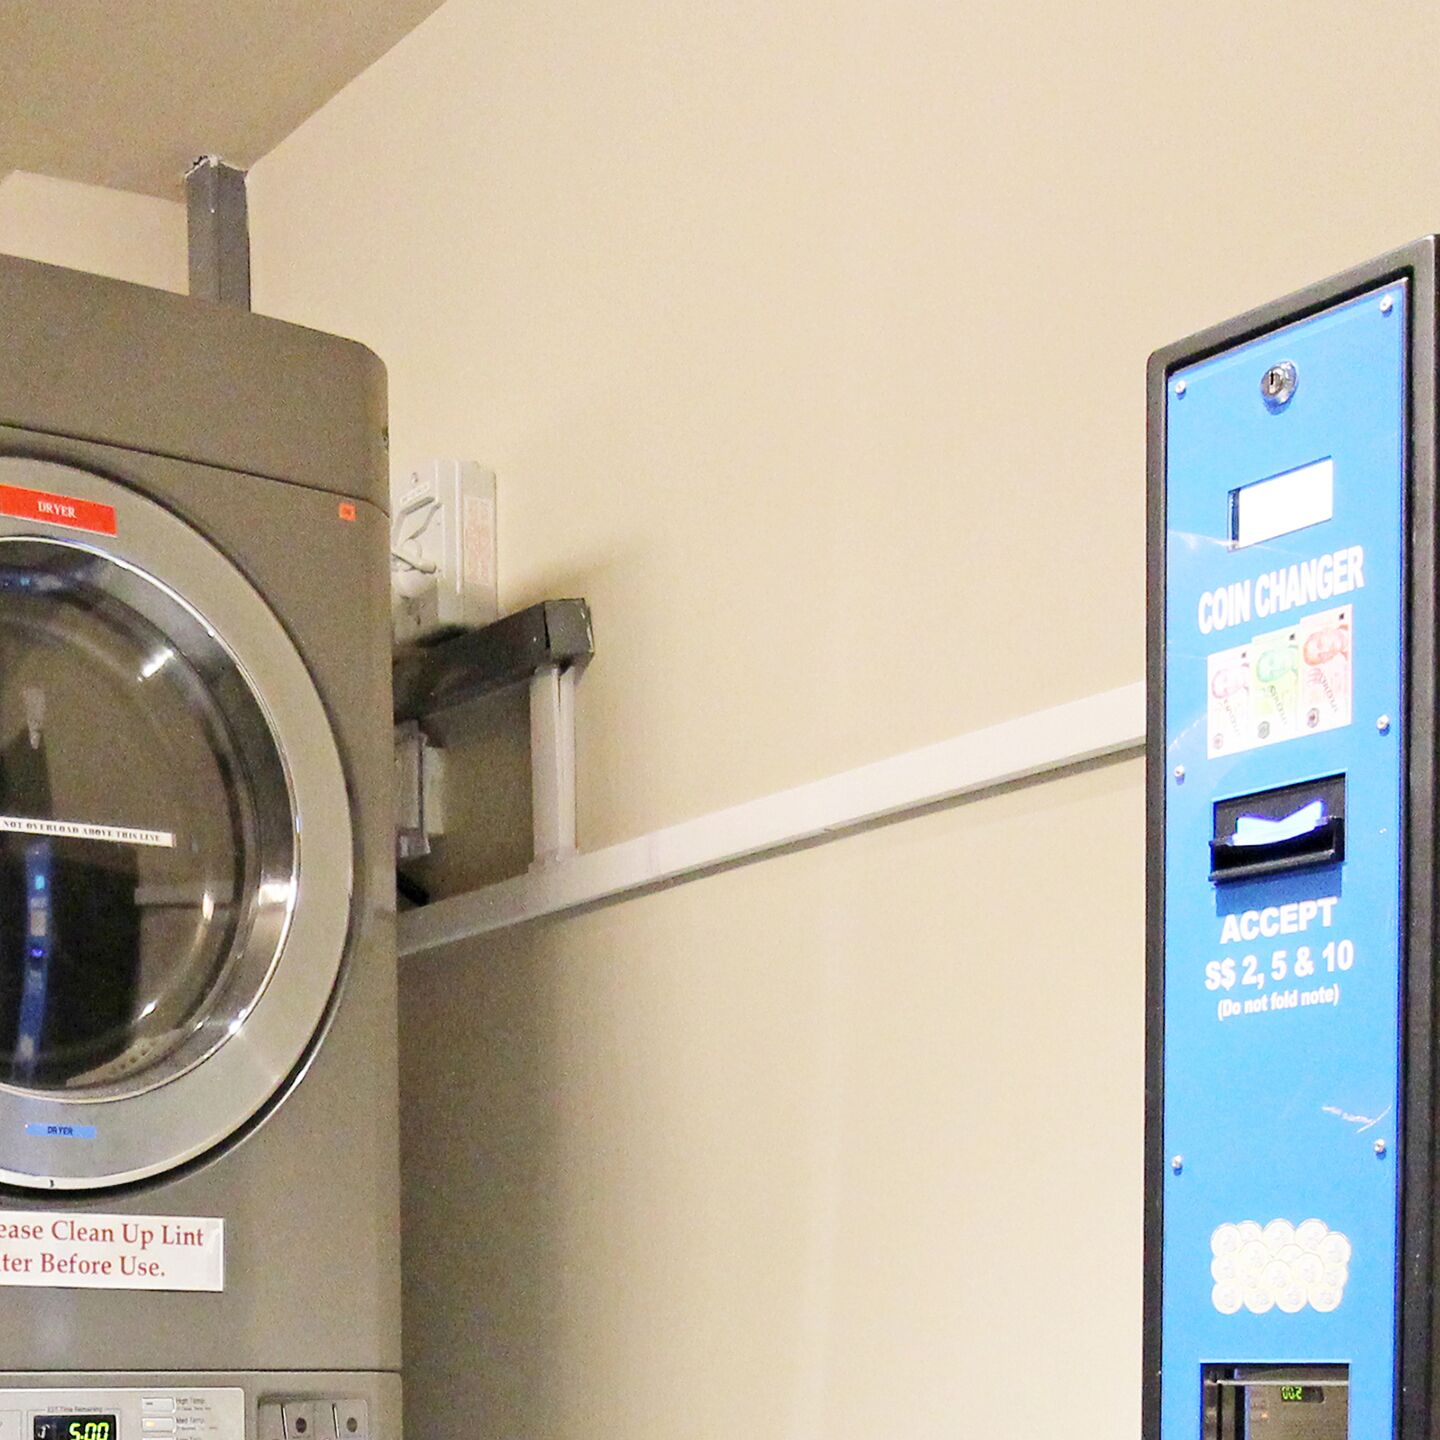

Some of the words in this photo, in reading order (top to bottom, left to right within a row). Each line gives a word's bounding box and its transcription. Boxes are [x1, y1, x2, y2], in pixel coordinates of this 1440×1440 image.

[38, 501, 77, 518] DRYER
[1198, 579, 1251, 635] COIN
[1254, 545, 1365, 618] CHANGER
[4, 820, 22, 829] NOT
[26, 823, 79, 834] OVERLOAD
[83, 828, 112, 838] ABOVE
[116, 831, 138, 840] THIS
[140, 833, 160, 842] LINE
[1219, 896, 1338, 944] ACCEPT
[1204, 957, 1236, 991] S$
[1241, 954, 1265, 990] 2,
[1271, 950, 1287, 981] 5
[1294, 946, 1315, 977] &
[1322, 939, 1354, 972] 10
[1217, 998, 1241, 1021] (Do
[1244, 994, 1268, 1014] not
[1270, 989, 1298, 1010] fold
[1301, 983, 1339, 1007] note)
[47, 1126, 73, 1136] DRYER
[51, 1219, 115, 1243] Clean
[122, 1223, 155, 1250] Up
[161, 1225, 205, 1247] Lint
[40, 1253, 112, 1277] Before
[119, 1256, 166, 1278] Use.
